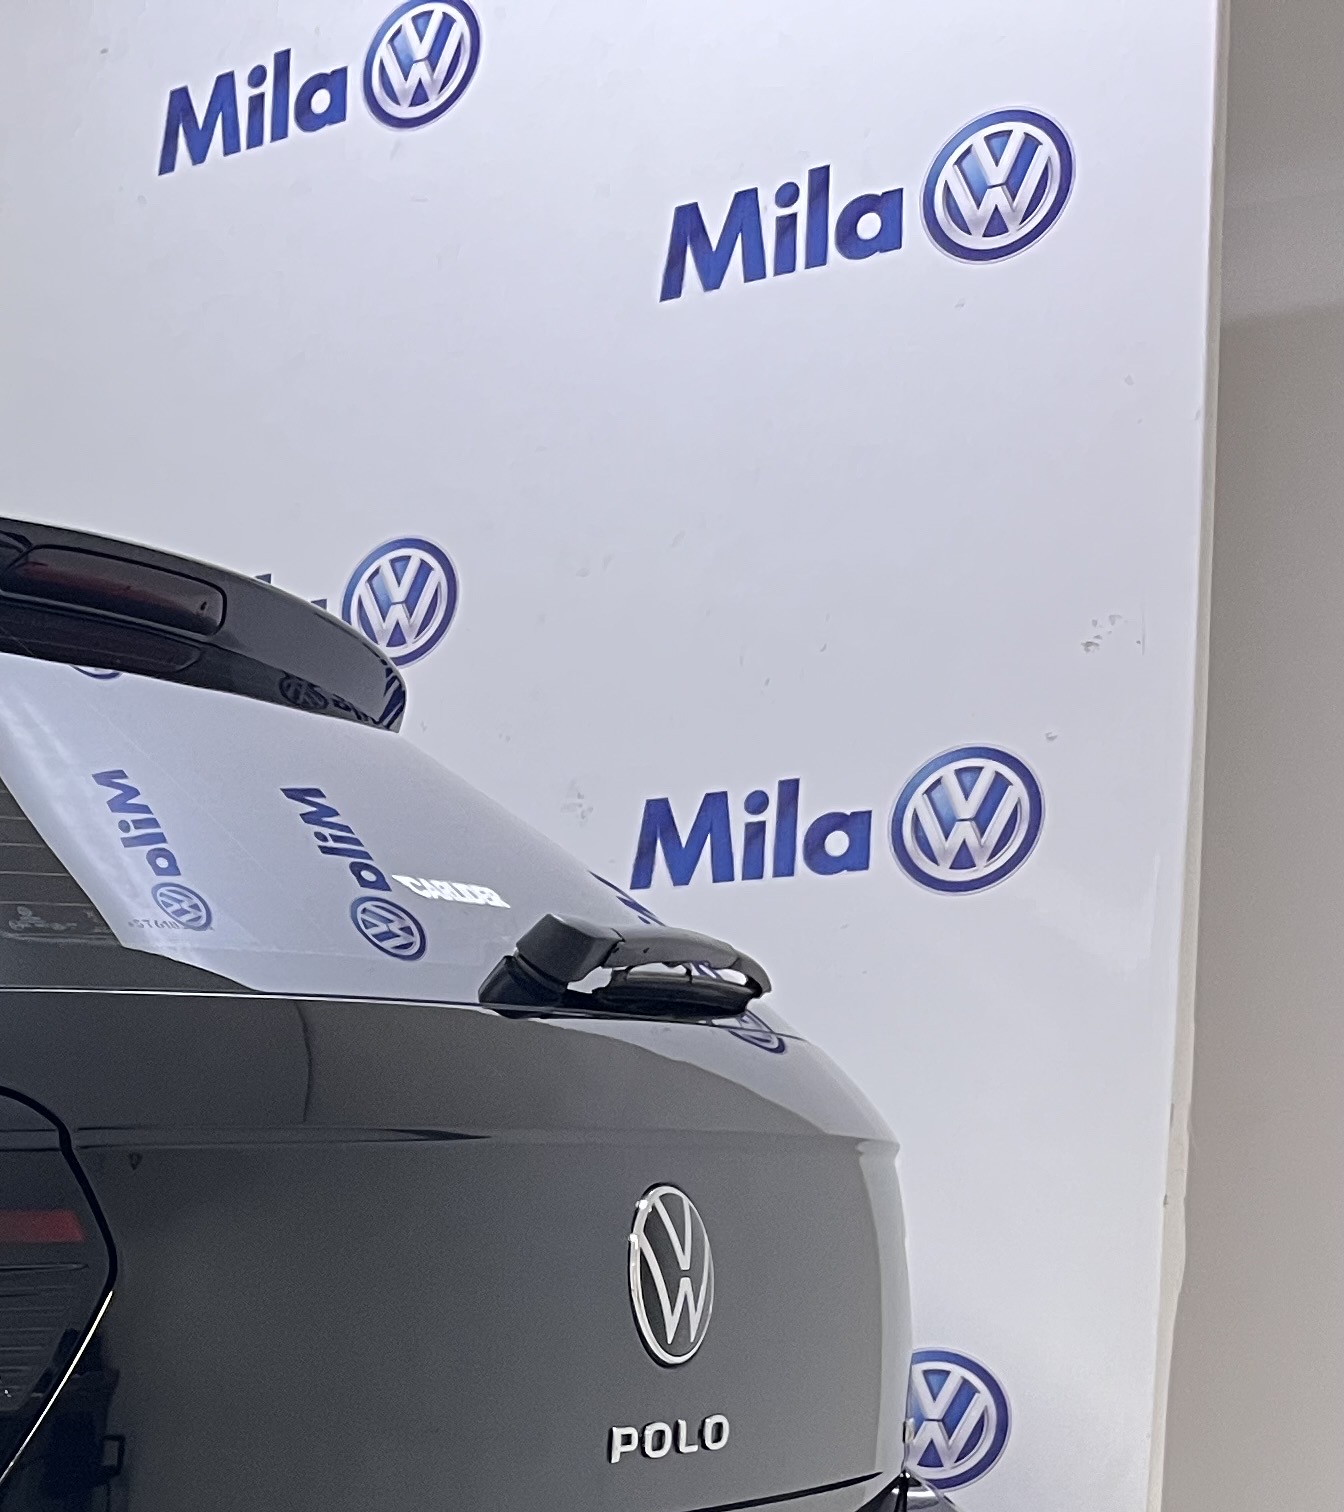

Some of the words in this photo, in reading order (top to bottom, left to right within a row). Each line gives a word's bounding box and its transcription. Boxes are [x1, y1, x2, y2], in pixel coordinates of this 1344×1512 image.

[158, 48, 347, 176] Mila
[660, 165, 903, 302] Mila
[630, 778, 872, 890] Mila
[610, 1414, 730, 1463] POLO
